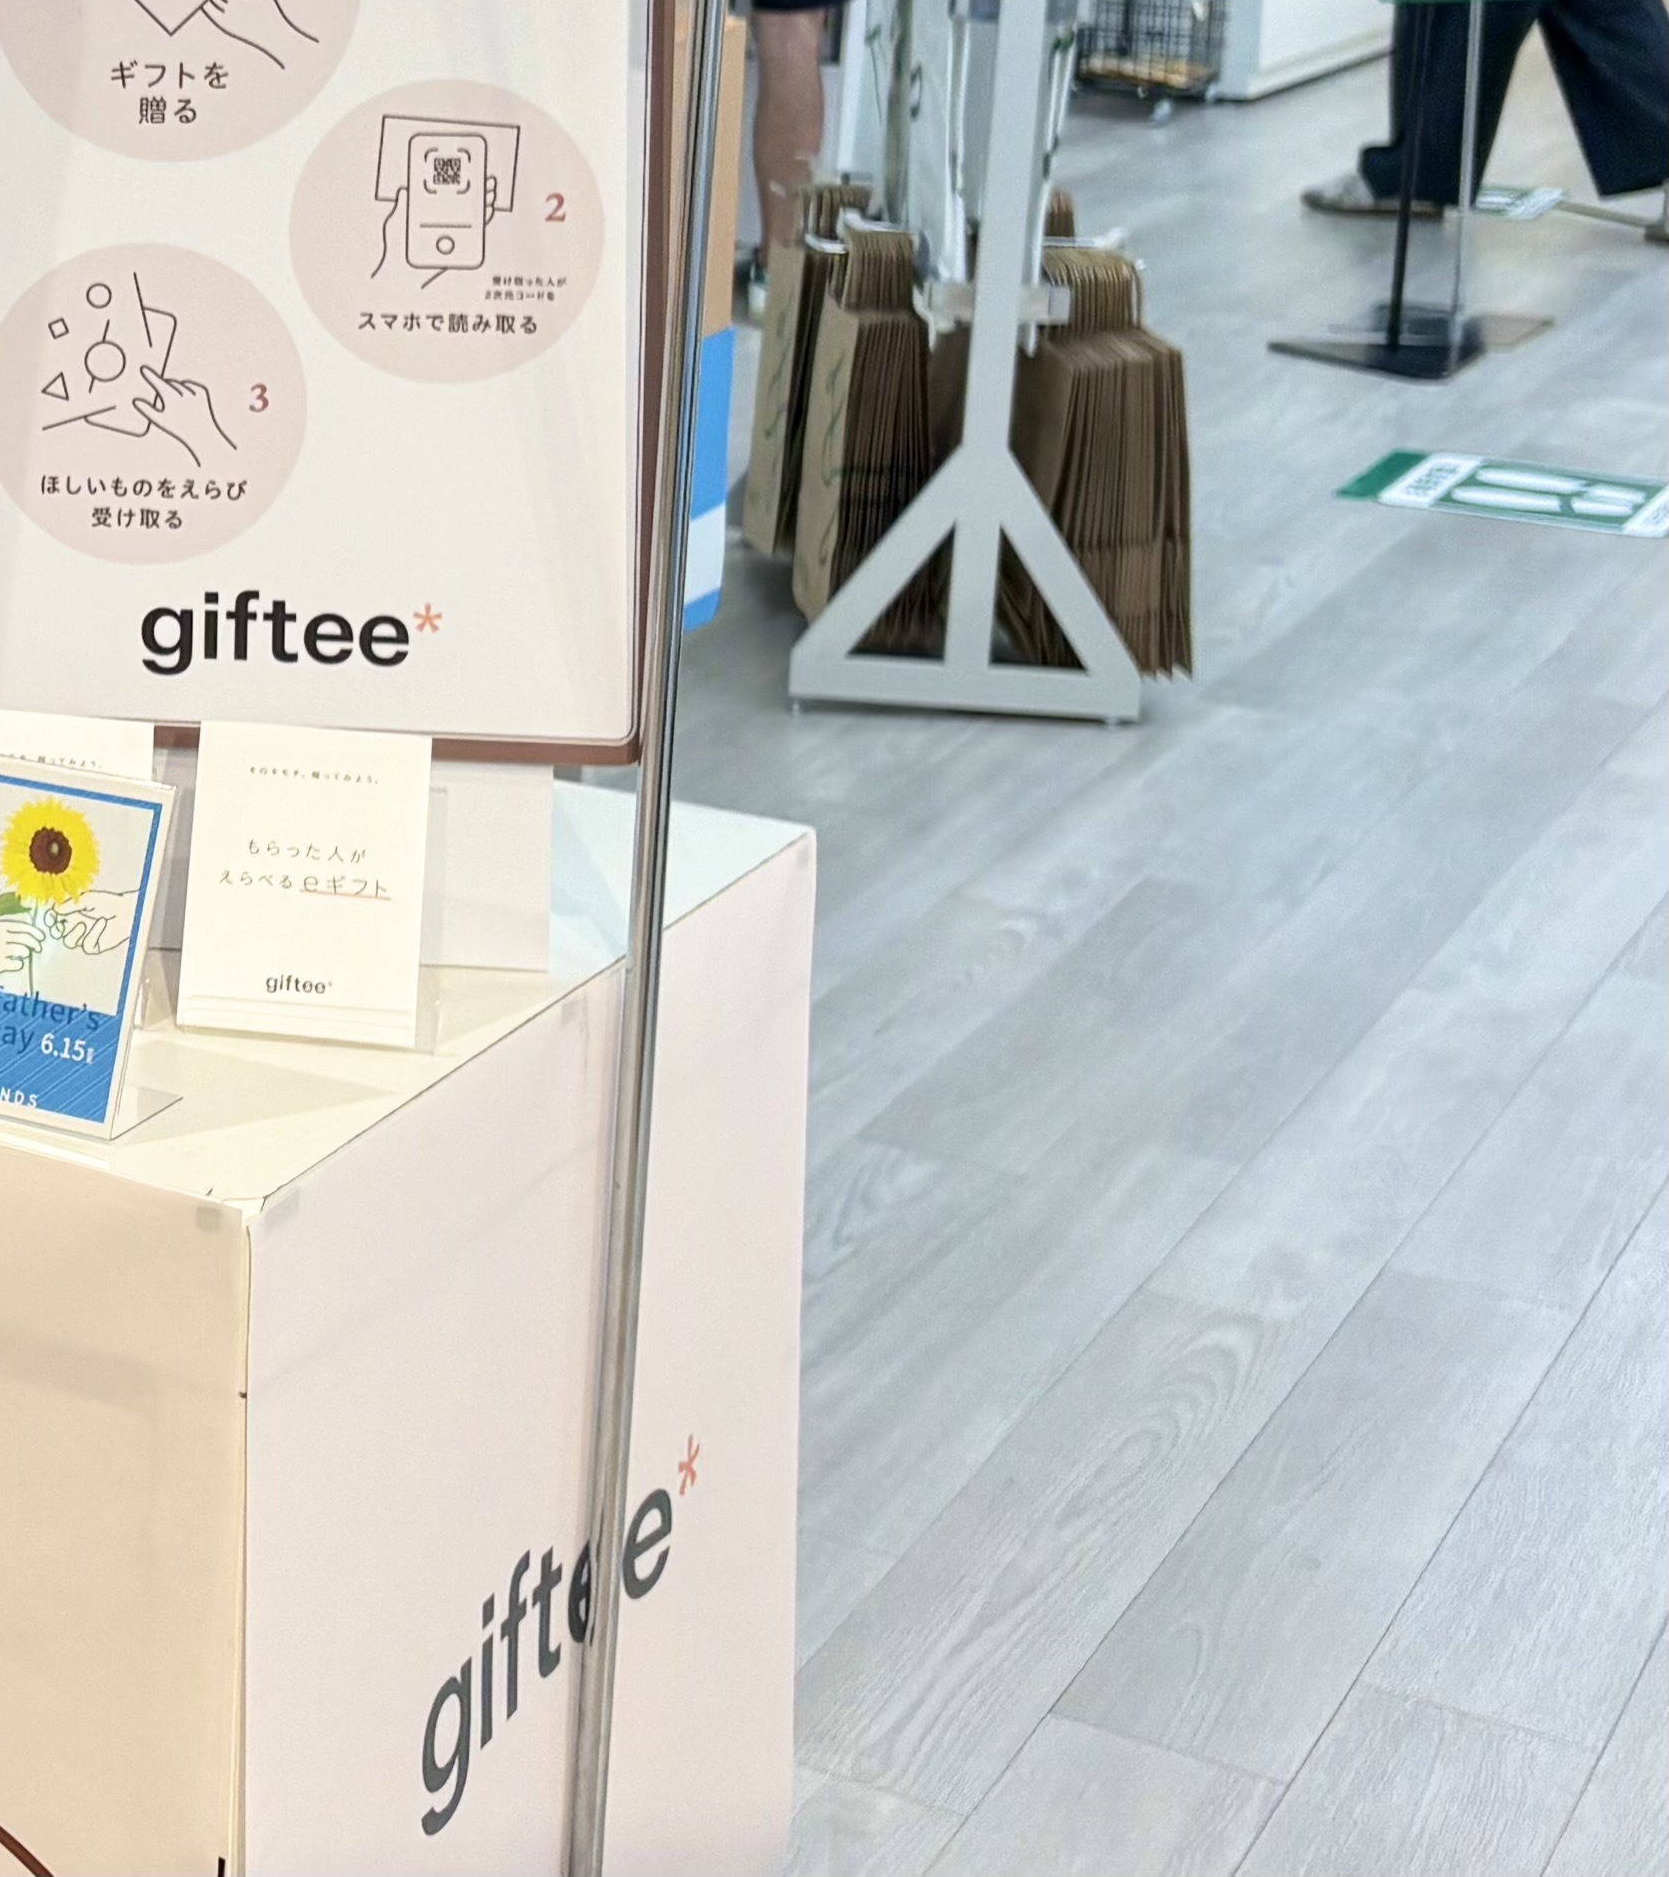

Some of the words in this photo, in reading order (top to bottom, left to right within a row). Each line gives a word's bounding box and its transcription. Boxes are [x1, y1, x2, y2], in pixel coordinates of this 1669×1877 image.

[109, 59, 230, 91] ギフトを
[137, 94, 199, 126] 贈る
[544, 193, 567, 223] 2
[357, 310, 539, 336] スマホで読み取る
[248, 383, 270, 413] 3
[39, 474, 248, 503] ほしいものをえらび
[90, 506, 184, 533] 受け取る
[141, 590, 411, 675] giftee
[248, 838, 366, 864] もらった人が
[219, 869, 388, 899] えらべるeギフト
[266, 975, 326, 996] giftee
[41, 1032, 86, 1062] 6.15
